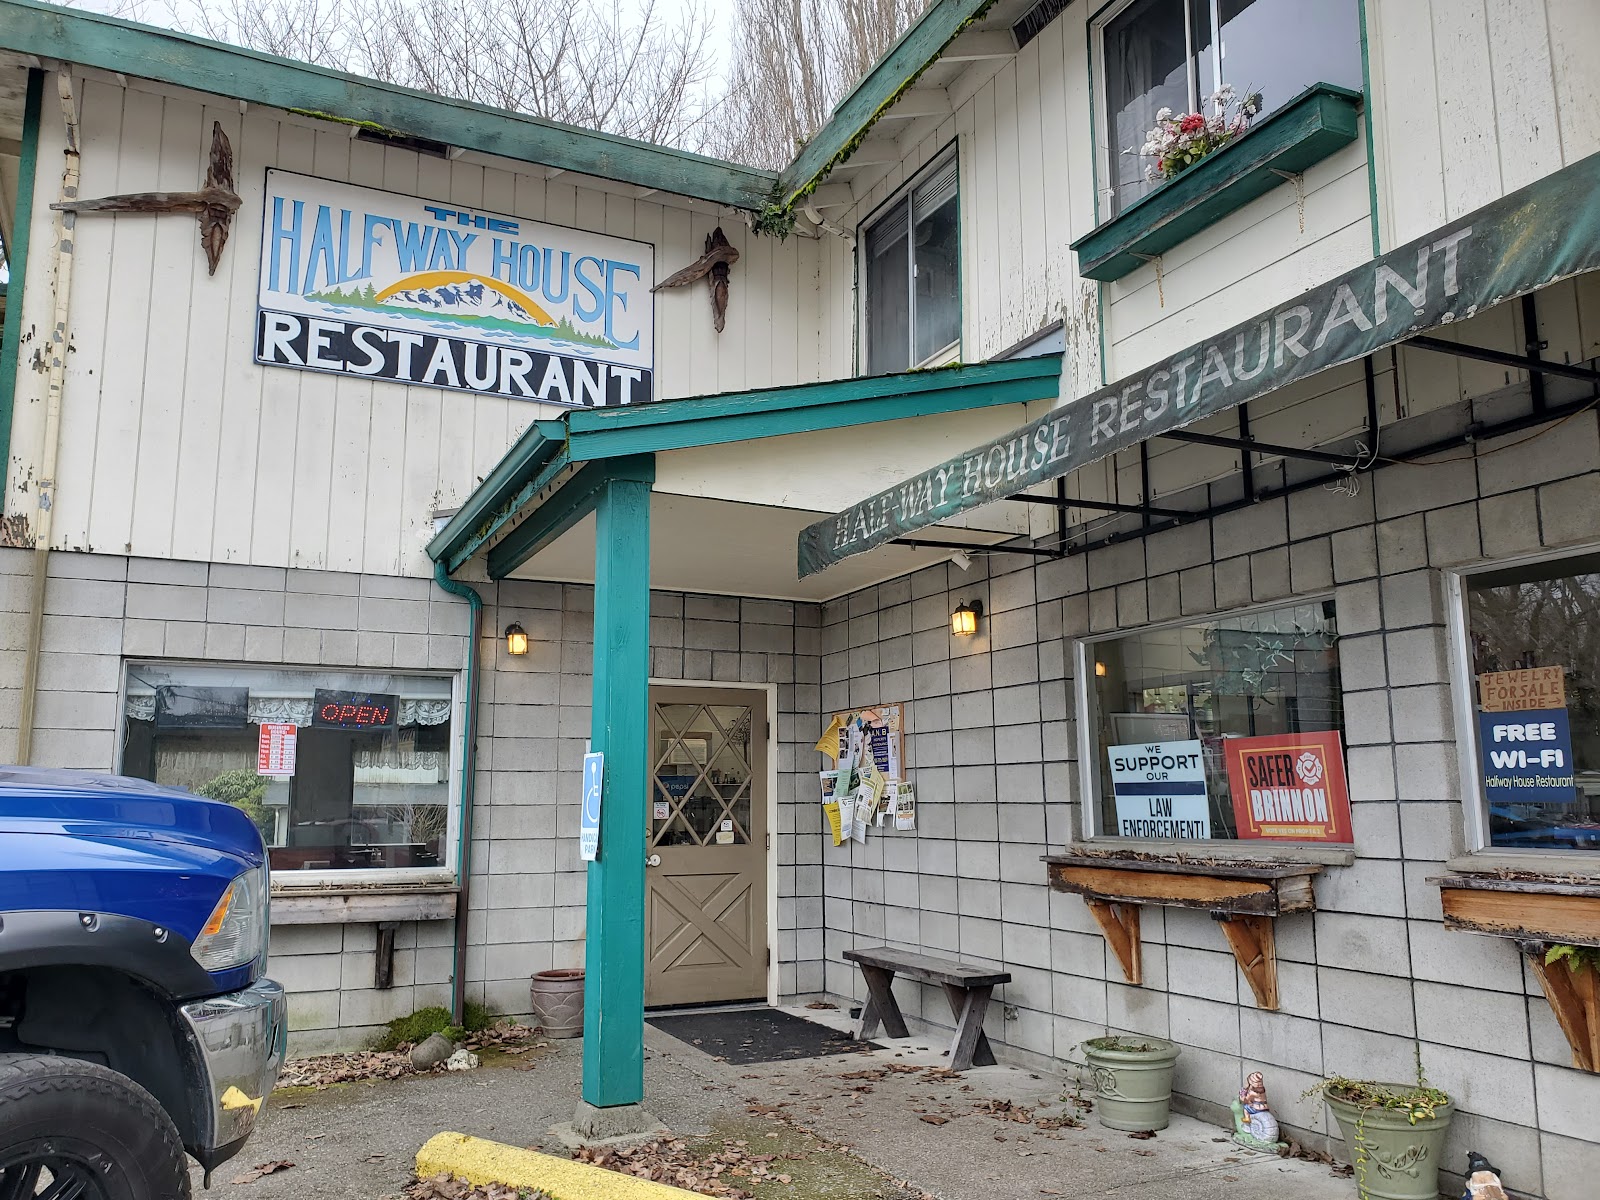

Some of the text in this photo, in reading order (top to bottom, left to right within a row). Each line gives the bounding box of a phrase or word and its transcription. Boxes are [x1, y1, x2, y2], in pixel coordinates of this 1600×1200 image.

[424, 205, 520, 236] THE
[267, 196, 641, 351] HALFWAY HOUSE
[262, 311, 642, 407] RESTAURANT
[961, 416, 1072, 499] HOUSE
[1091, 226, 1473, 446] RESTAURANT
[1484, 667, 1560, 686] JEWELRY
[322, 704, 389, 724] OPEN
[1502, 698, 1546, 711] INSIDE
[1493, 722, 1557, 742] FREE
[1145, 745, 1161, 753] WE
[1490, 749, 1564, 769] WI-FI
[1115, 755, 1199, 771] SUPPORT
[1247, 754, 1296, 787] SAFER
[1146, 772, 1169, 780] OUR
[1485, 775, 1574, 789] Halfway House Restaurant
[670, 783, 689, 791] pepsi
[1149, 798, 1172, 817] LAW
[1251, 788, 1329, 822] BRINNON
[1123, 819, 1204, 839] ENFORCEMENT!
